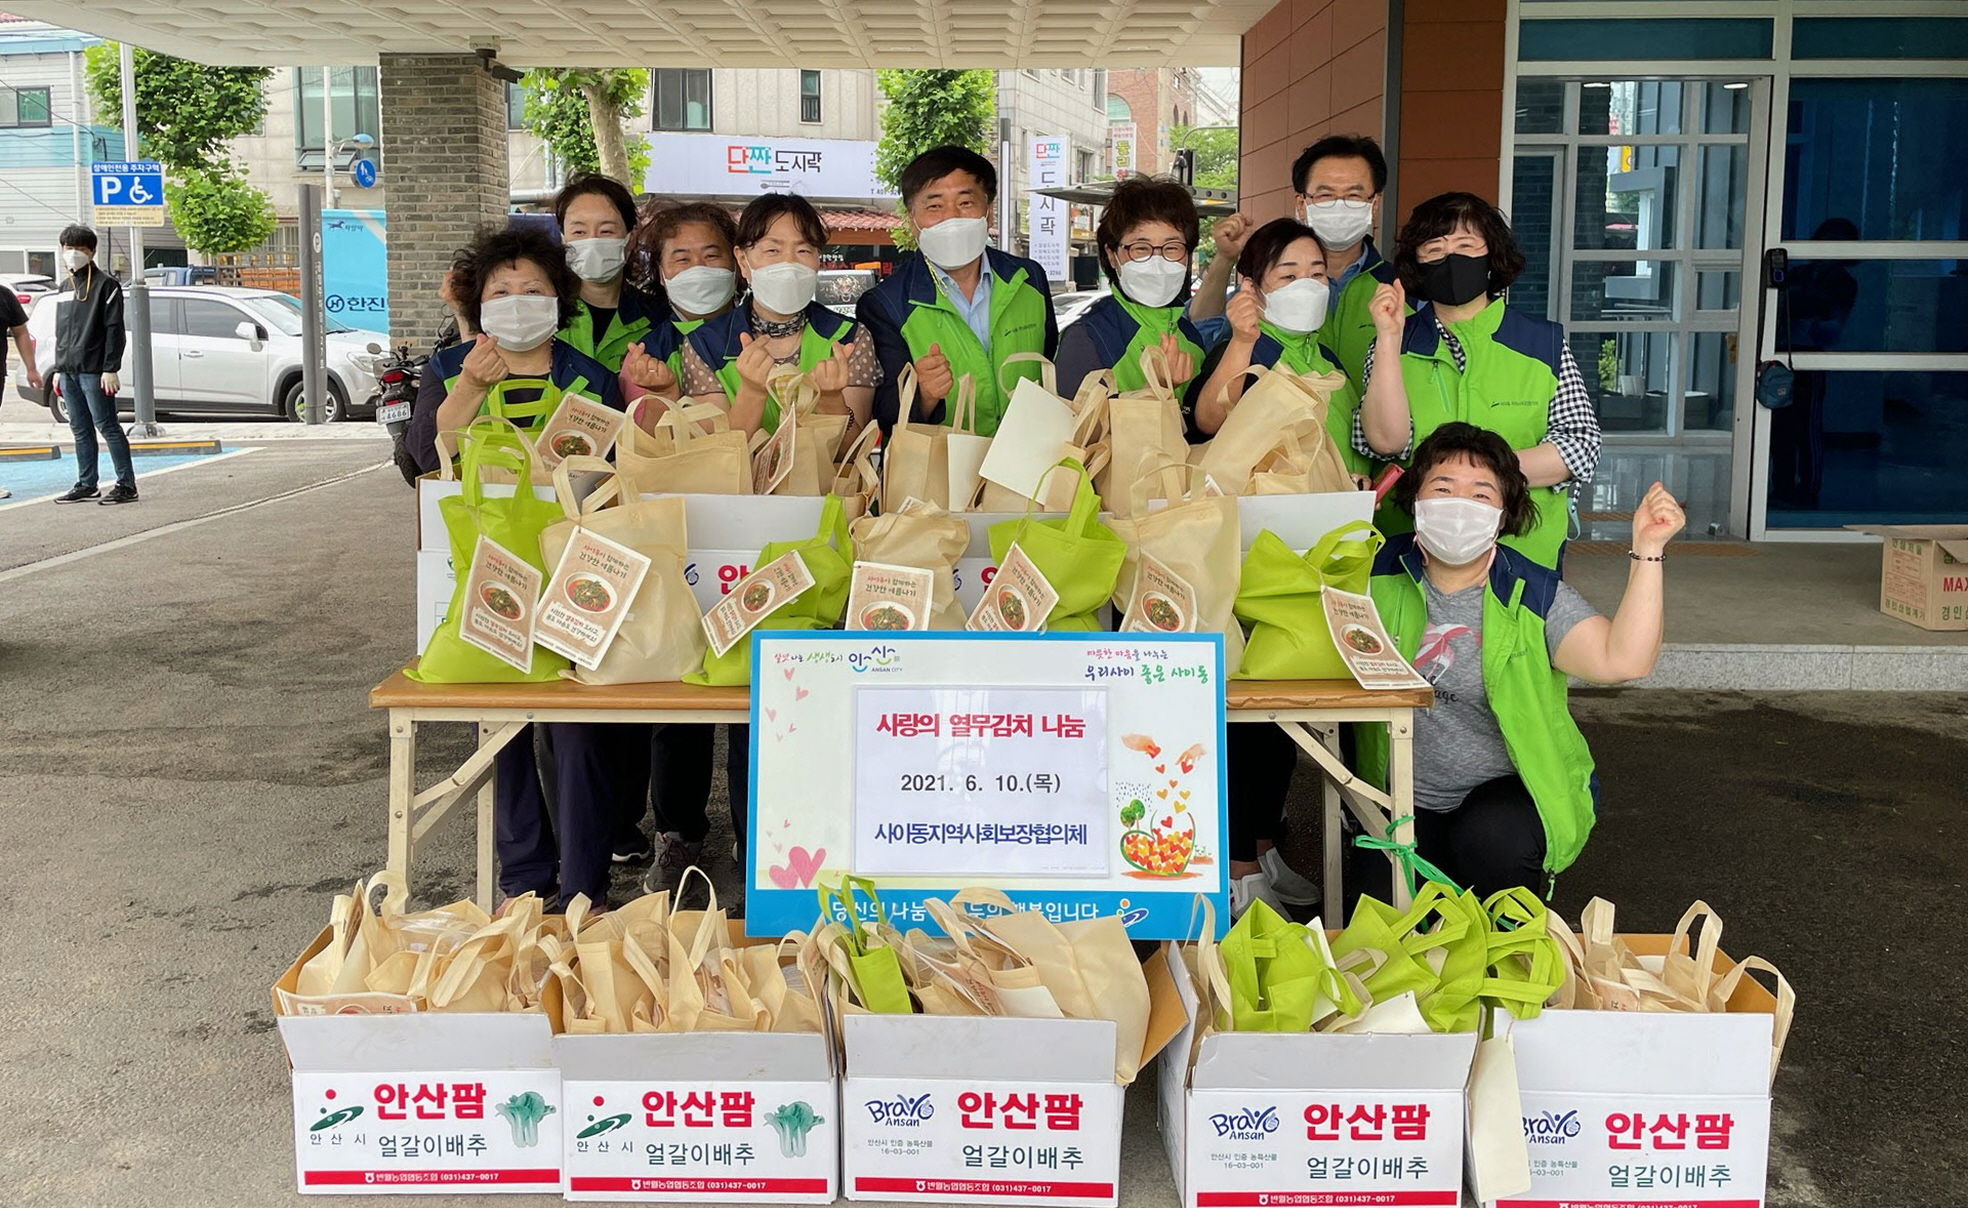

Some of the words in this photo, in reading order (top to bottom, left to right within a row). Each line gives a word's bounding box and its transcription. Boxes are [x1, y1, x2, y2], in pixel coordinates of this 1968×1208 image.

[727, 145, 772, 174] 단짠
[774, 150, 822, 173] 도시락
[101, 176, 122, 204] P
[347, 296, 386, 311] 한진
[486, 560, 503, 577] 건강한
[504, 573, 527, 590] 여름나기
[580, 552, 600, 567] 건강한
[601, 562, 627, 579] 여름나기
[866, 583, 887, 595] 건강한
[888, 587, 917, 597] 여름나기
[1087, 648, 1112, 660] 따뜻한
[1115, 649, 1141, 662] 마음을
[1143, 649, 1169, 660] 나누는
[1140, 664, 1166, 685] 좋은
[1171, 664, 1209, 685] 사이동
[876, 713, 940, 738] 사랑의
[949, 713, 1033, 738] 열무김치
[1041, 714, 1087, 739] 나눔
[900, 774, 953, 791] 2021.
[965, 774, 983, 791] 6.
[874, 822, 1088, 845] 사이동지역사회보장협의체
[892, 901, 926, 922] 나눔
[374, 1083, 487, 1120] 안산팜
[642, 1091, 756, 1128] 안산팜
[957, 1092, 1084, 1131] 안산팜
[885, 1117, 920, 1127] Ansan
[1303, 1104, 1431, 1141] 안산팜
[1605, 1113, 1735, 1150] 안산팜
[379, 1134, 487, 1157] 얼갈이배추
[1229, 1130, 1265, 1141] Ansan
[1529, 1133, 1565, 1145] Ansan
[646, 1143, 756, 1166] 얼갈이배추
[962, 1144, 1084, 1170] 얼갈이배추
[1307, 1156, 1429, 1180] 얼갈이배추
[1608, 1165, 1732, 1188] 얼갈이배추
